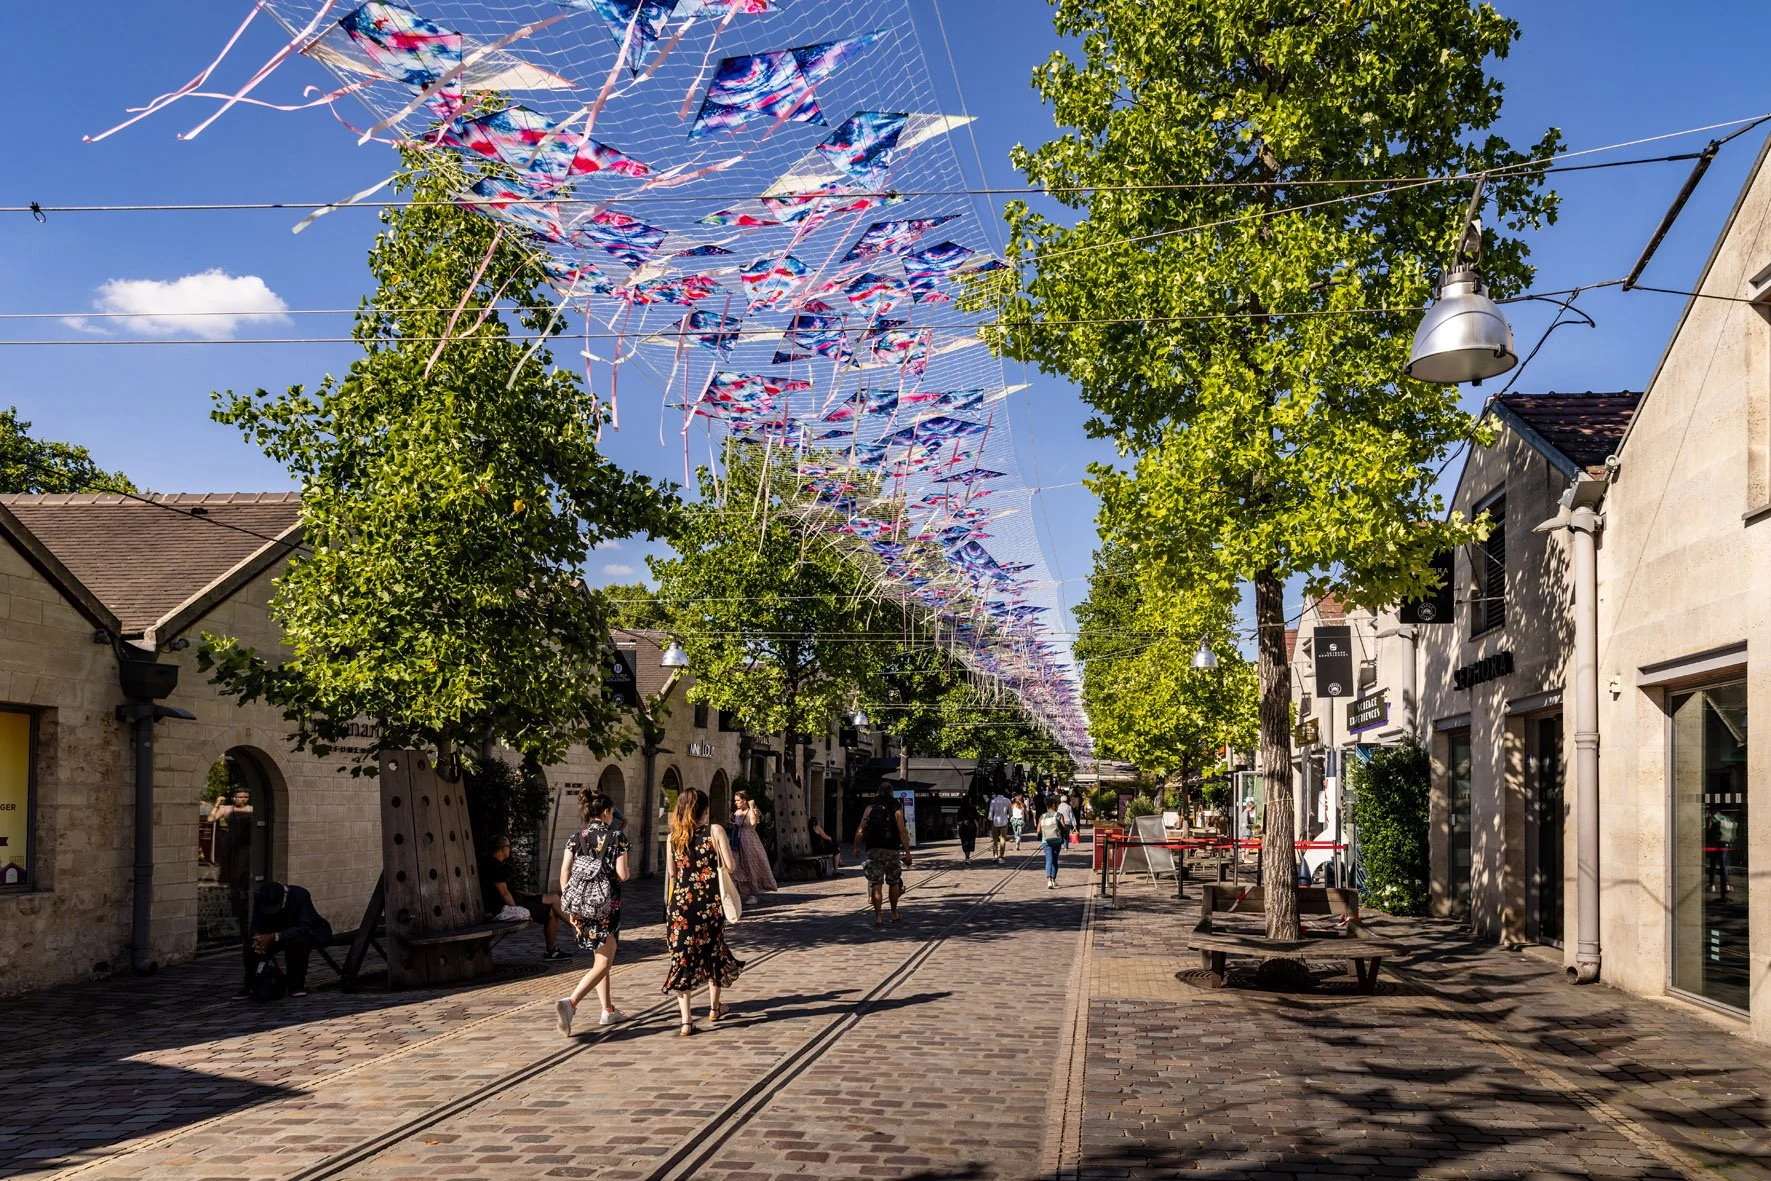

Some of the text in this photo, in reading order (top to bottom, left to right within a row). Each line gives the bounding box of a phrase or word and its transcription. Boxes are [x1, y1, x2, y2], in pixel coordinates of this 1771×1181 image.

[1454, 651, 1514, 690] SEPHORA
[1357, 696, 1377, 712] SCIENCE
[1349, 707, 1380, 726] EXPERIENCES
